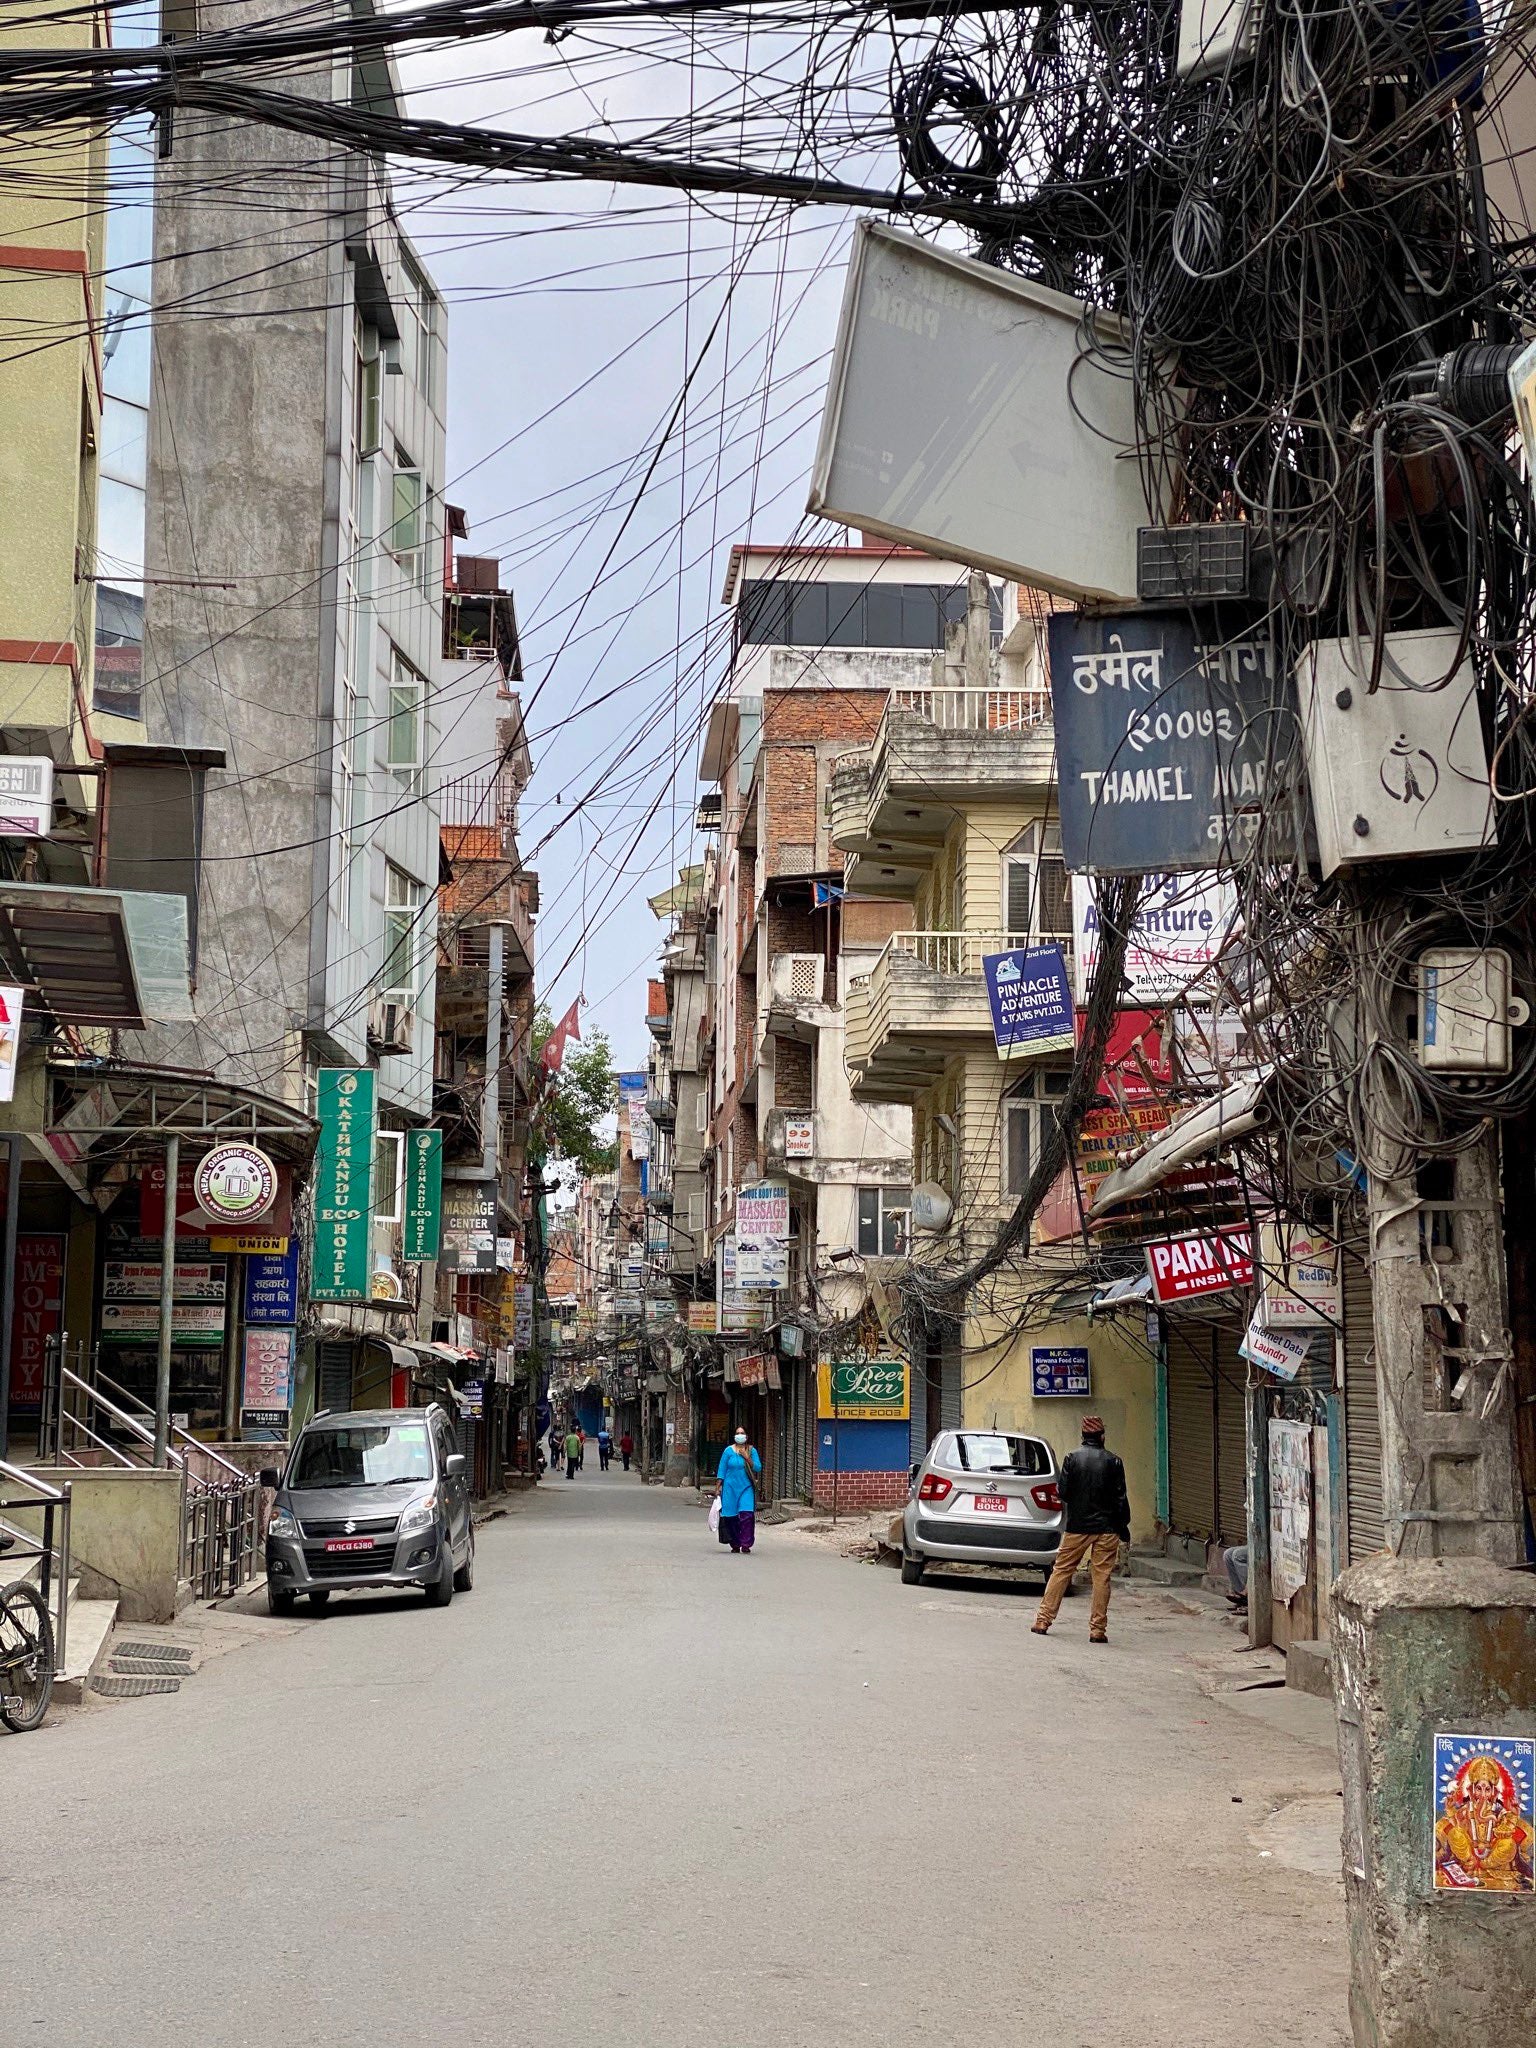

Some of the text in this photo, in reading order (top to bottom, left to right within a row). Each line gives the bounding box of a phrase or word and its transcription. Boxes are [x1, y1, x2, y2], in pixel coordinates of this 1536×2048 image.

[1072, 634, 1164, 694] ठमेल
[1081, 766, 1192, 804] THAMEL
[1083, 905, 1213, 933] Aenture
[1026, 948, 1057, 959] 2nd Floor
[997, 975, 1060, 998] PINNACLE
[1001, 990, 1062, 1012] ADVENTURE
[1001, 1015, 1008, 1025] &
[1008, 1011, 1034, 1022] TOURS
[335, 1096, 353, 1206] KATHMANDU
[786, 1140, 811, 1150] Snooker
[1082, 1138, 1105, 1152] REAL
[1107, 1138, 1116, 1150] &
[200, 1168, 211, 1194] NEPAL
[208, 1149, 242, 1168] ORGANIC
[243, 1150, 270, 1175] COFFEE
[261, 1174, 272, 1198] SHOP
[416, 1148, 428, 1210] KATHMANDU
[476, 1188, 484, 1199] &
[321, 1208, 362, 1220] ECO
[444, 1201, 495, 1216] MASSAGE
[737, 1200, 787, 1219] MASSAGE
[449, 1218, 488, 1229] CENTER
[740, 1220, 784, 1234] CENTER
[238, 1240, 280, 1249] UNION
[416, 1217, 425, 1253] HOTEL
[333, 1223, 348, 1286] HOTEL
[1153, 1231, 1253, 1280] PARKIN
[262, 1266, 283, 1275] ऋण
[254, 1278, 290, 1289] सहकारी
[252, 1291, 291, 1302] संस्था लि.
[315, 1289, 362, 1298] PVT. LTD.
[1270, 1300, 1306, 1314] The
[20, 1260, 47, 1386] MONEY
[1250, 1321, 1304, 1357] Internet Data
[1253, 1338, 1289, 1364] Laundry
[258, 1341, 279, 1397] MONEY
